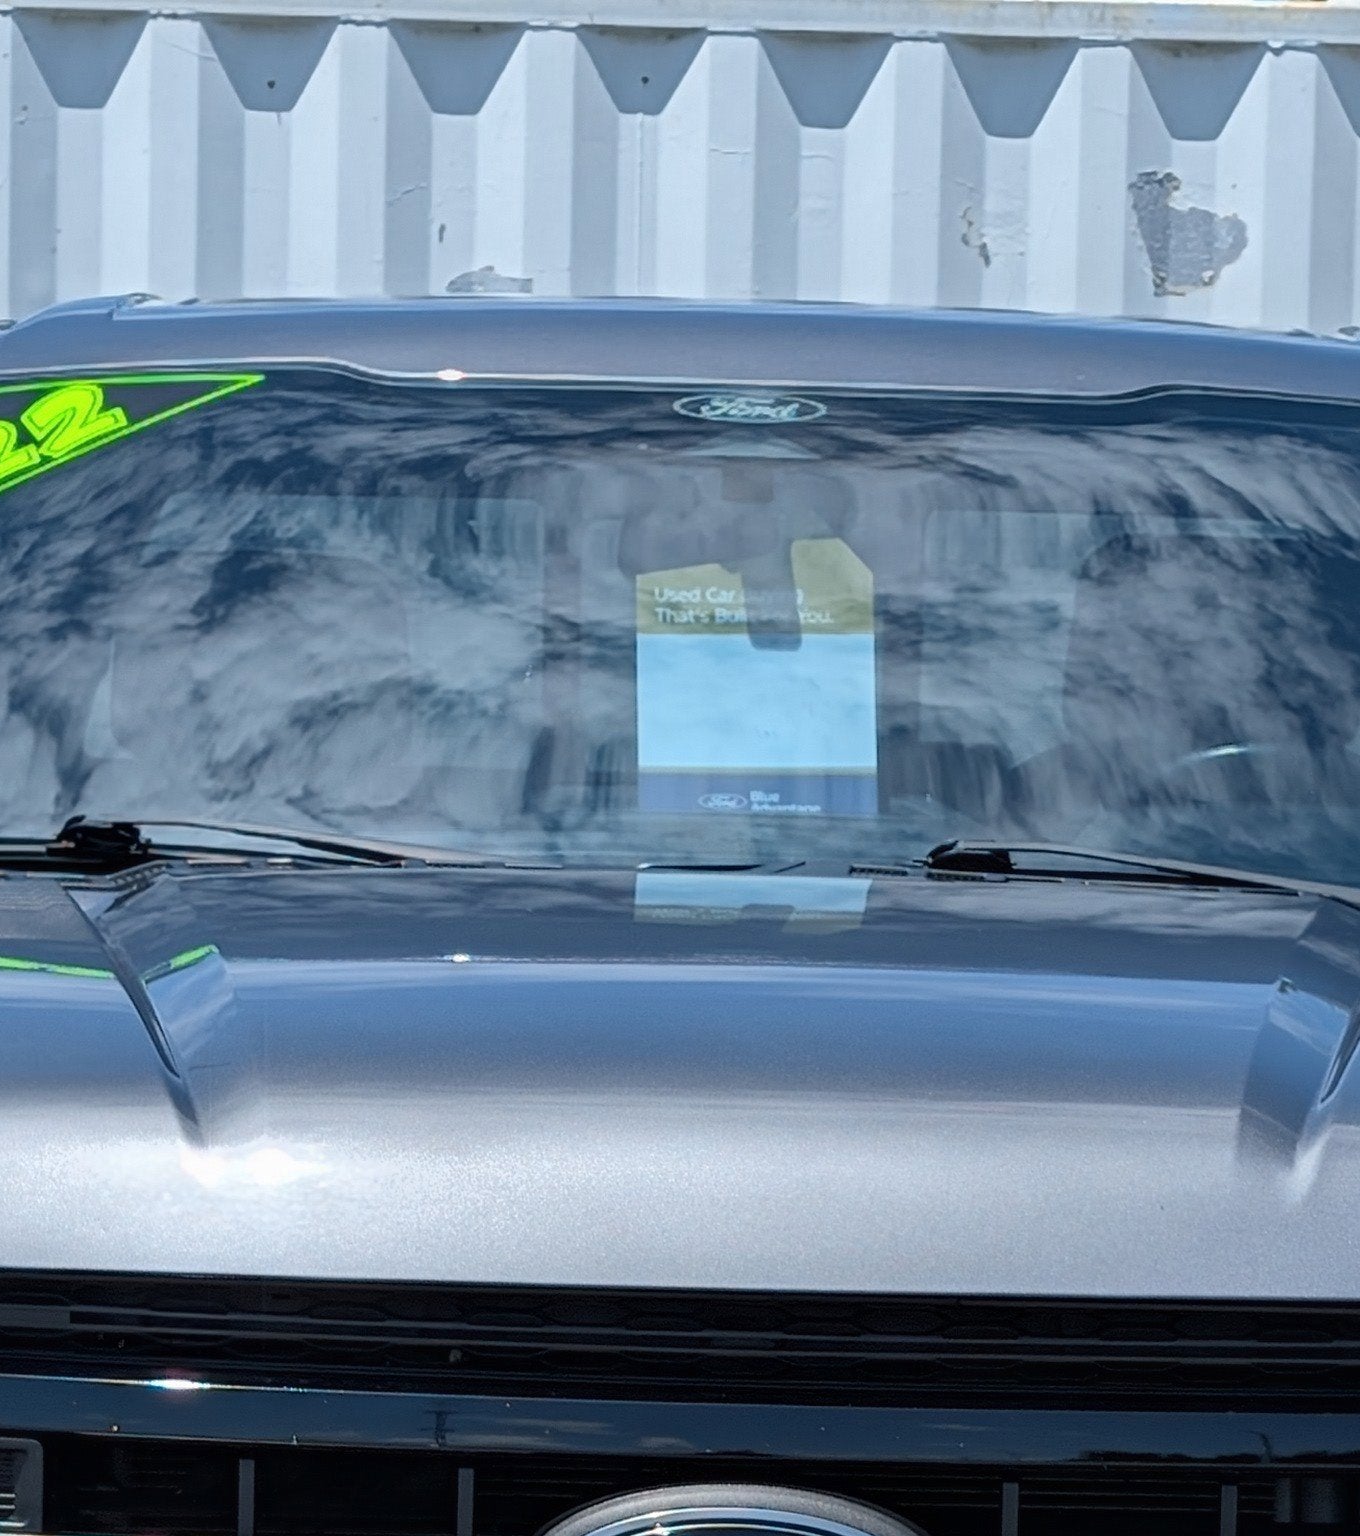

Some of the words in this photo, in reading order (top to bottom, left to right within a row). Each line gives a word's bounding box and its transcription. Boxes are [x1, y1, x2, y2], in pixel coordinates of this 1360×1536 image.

[700, 395, 800, 419] Ford
[654, 587, 701, 603] Used
[705, 587, 735, 603] Car
[655, 607, 708, 624] That's
[750, 790, 780, 802] Blue
